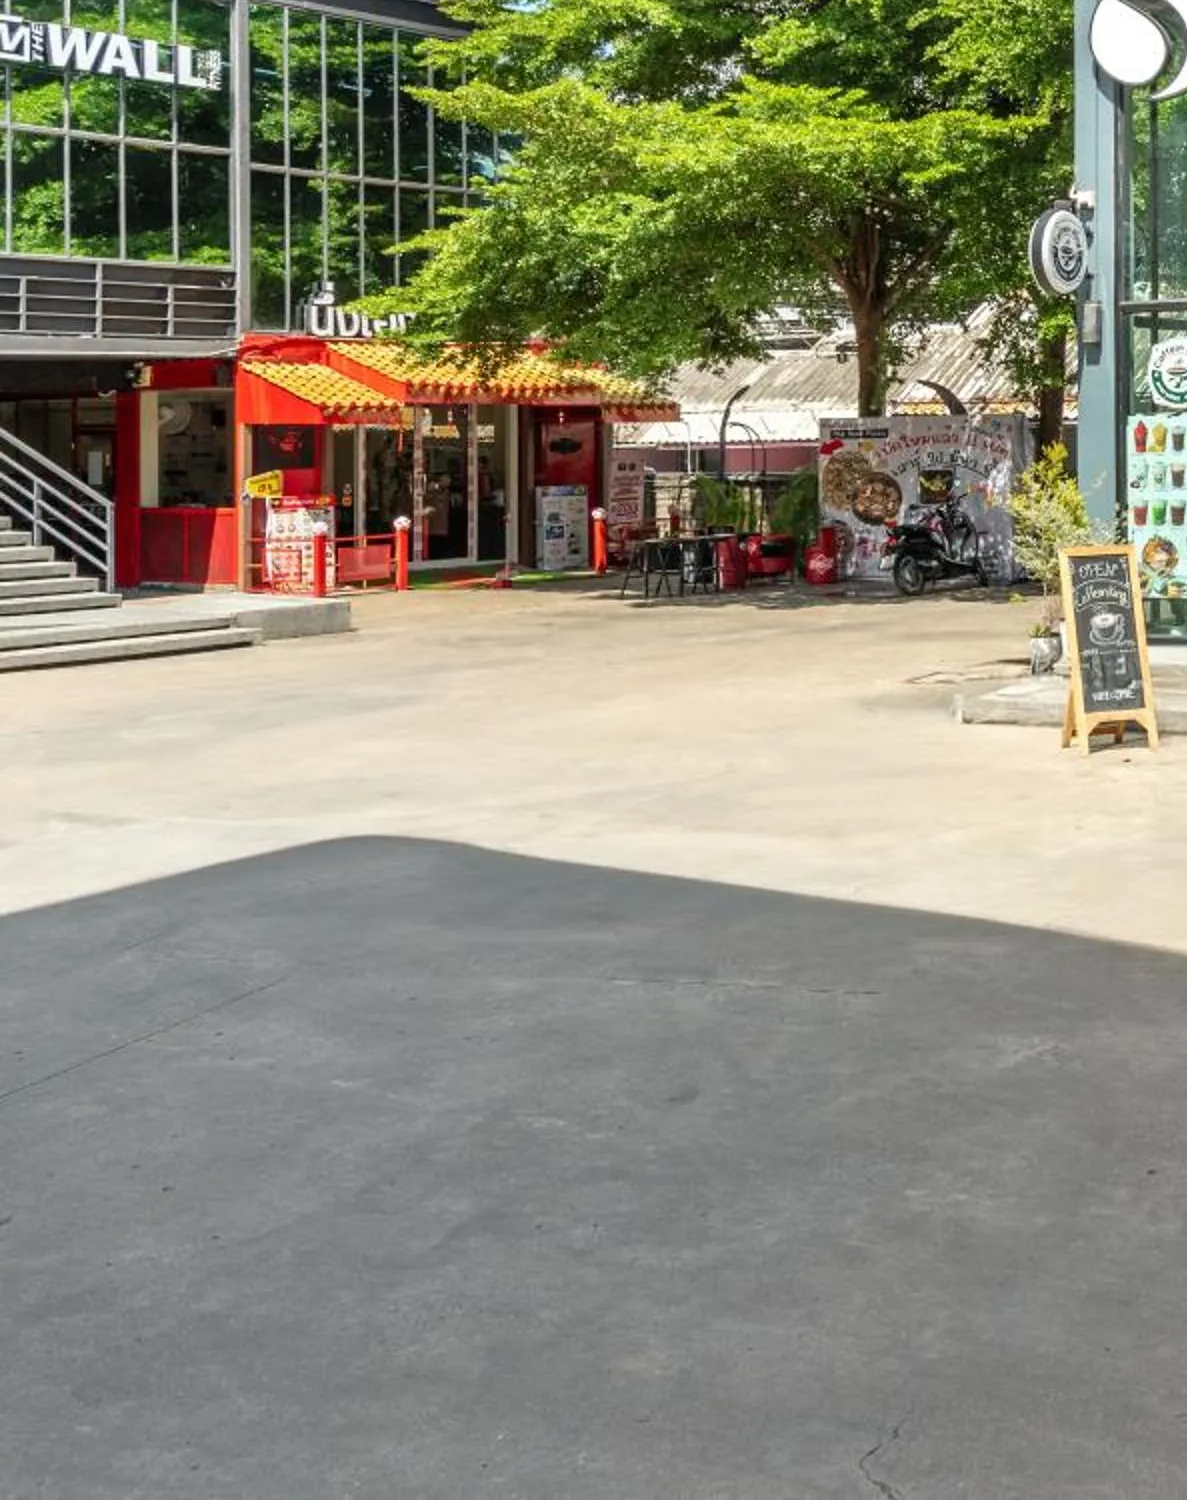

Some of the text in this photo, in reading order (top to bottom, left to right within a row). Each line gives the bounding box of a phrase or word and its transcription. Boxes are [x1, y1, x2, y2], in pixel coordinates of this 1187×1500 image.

[31, 22, 45, 62] THE
[48, 23, 207, 88] WALL
[1079, 562, 1119, 578] OPEN
